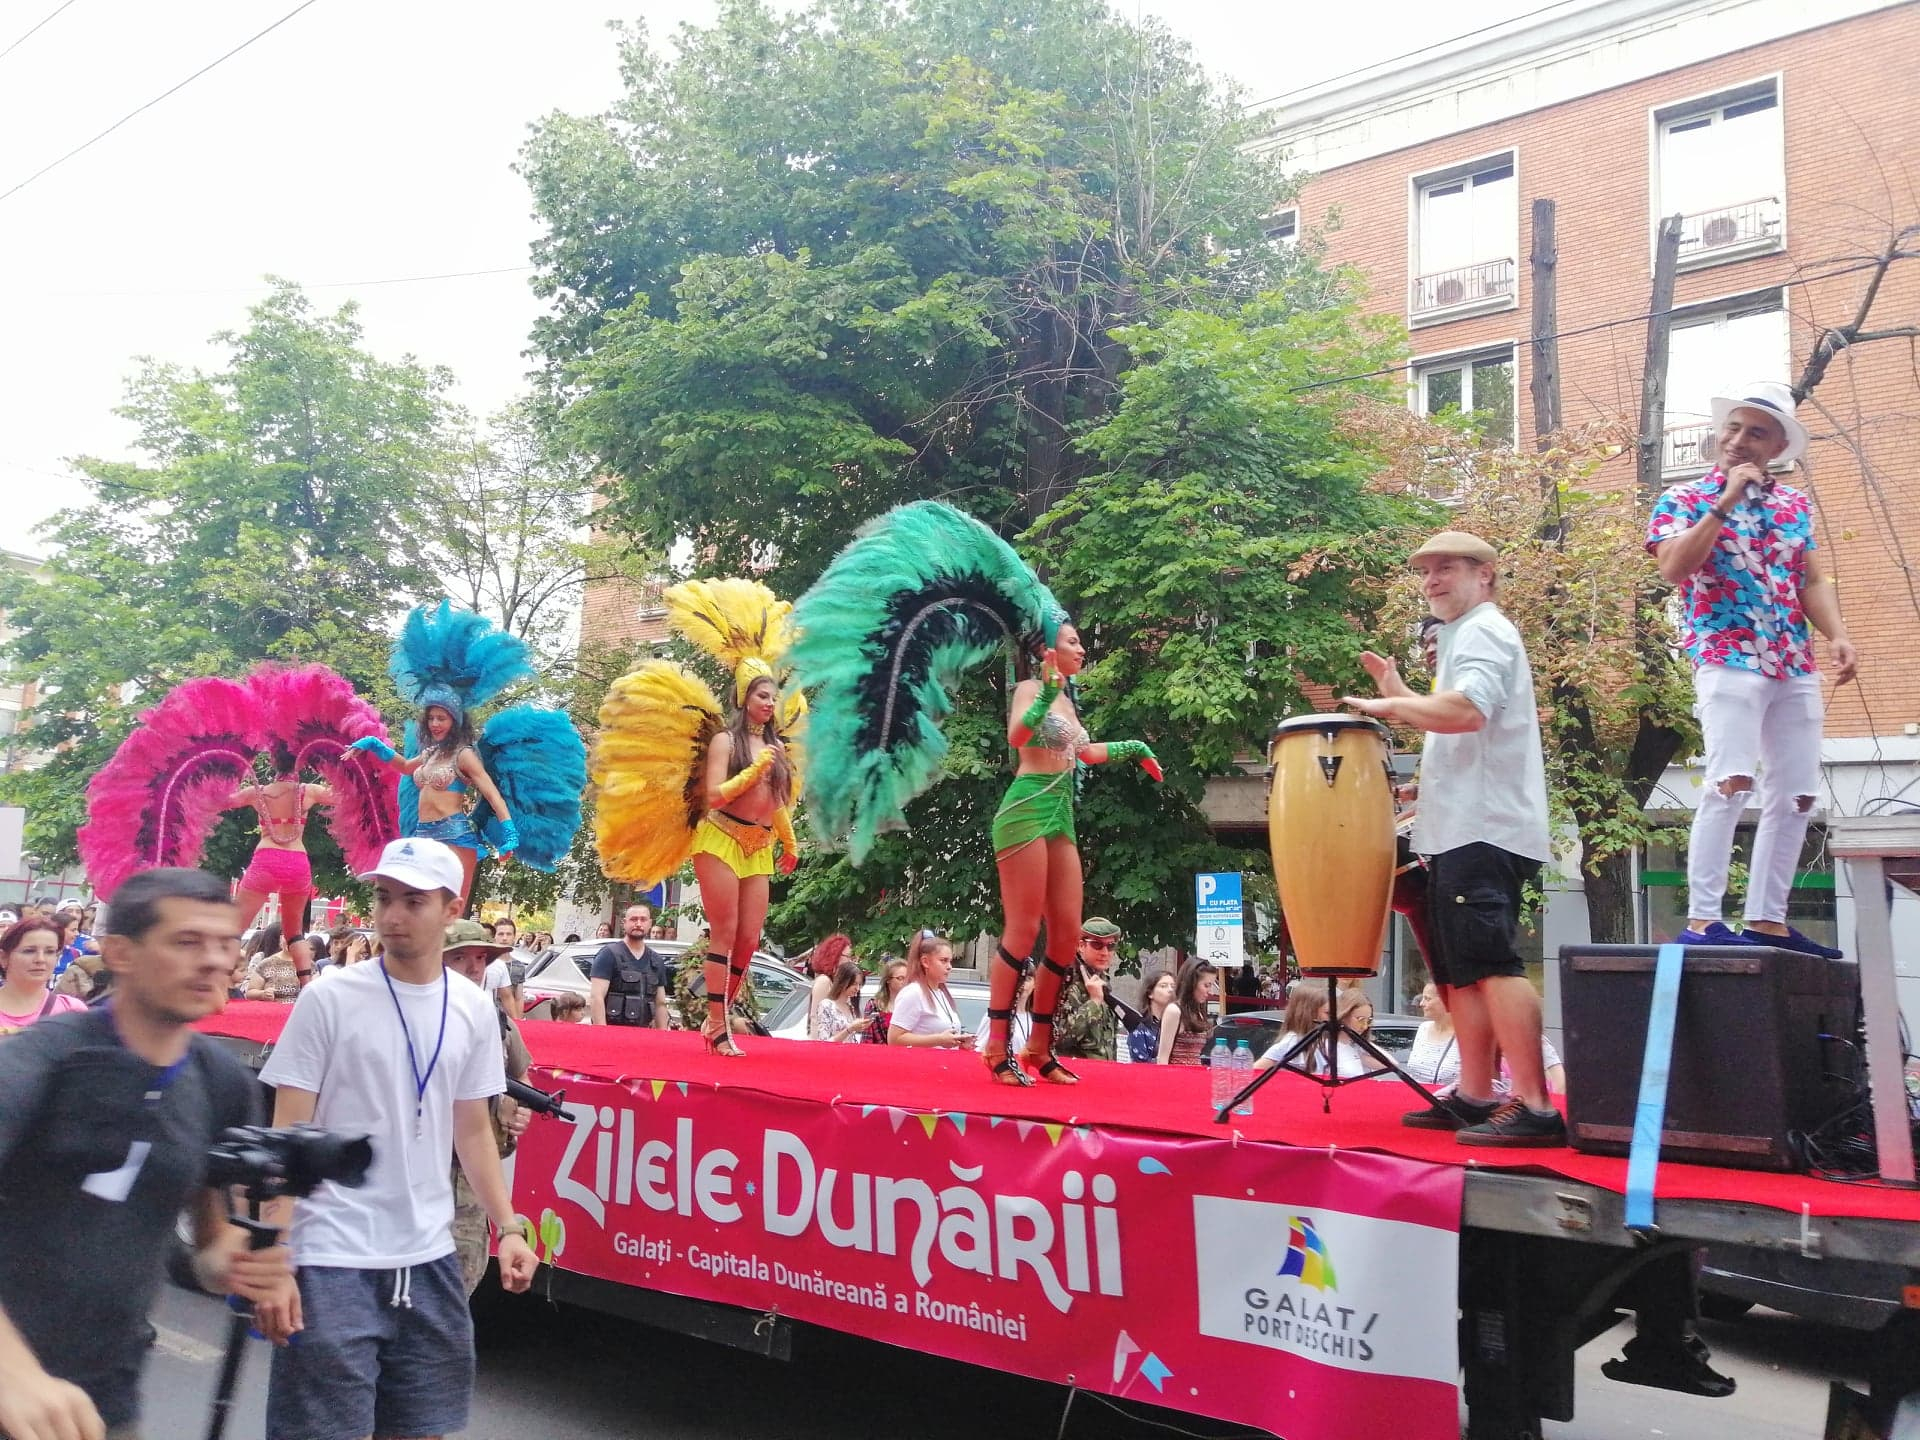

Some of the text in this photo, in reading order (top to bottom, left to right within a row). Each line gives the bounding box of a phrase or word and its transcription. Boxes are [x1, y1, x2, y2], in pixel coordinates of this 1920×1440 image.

[1198, 875, 1217, 906] P
[552, 1101, 1124, 1314] Zilele Dunării
[613, 1231, 672, 1267] Galați
[687, 1245, 770, 1281] Capitala
[774, 1261, 888, 1310] Dunăreană
[894, 1293, 908, 1314] a
[915, 1291, 1027, 1341] României
[1244, 1312, 1292, 1341] PORT
